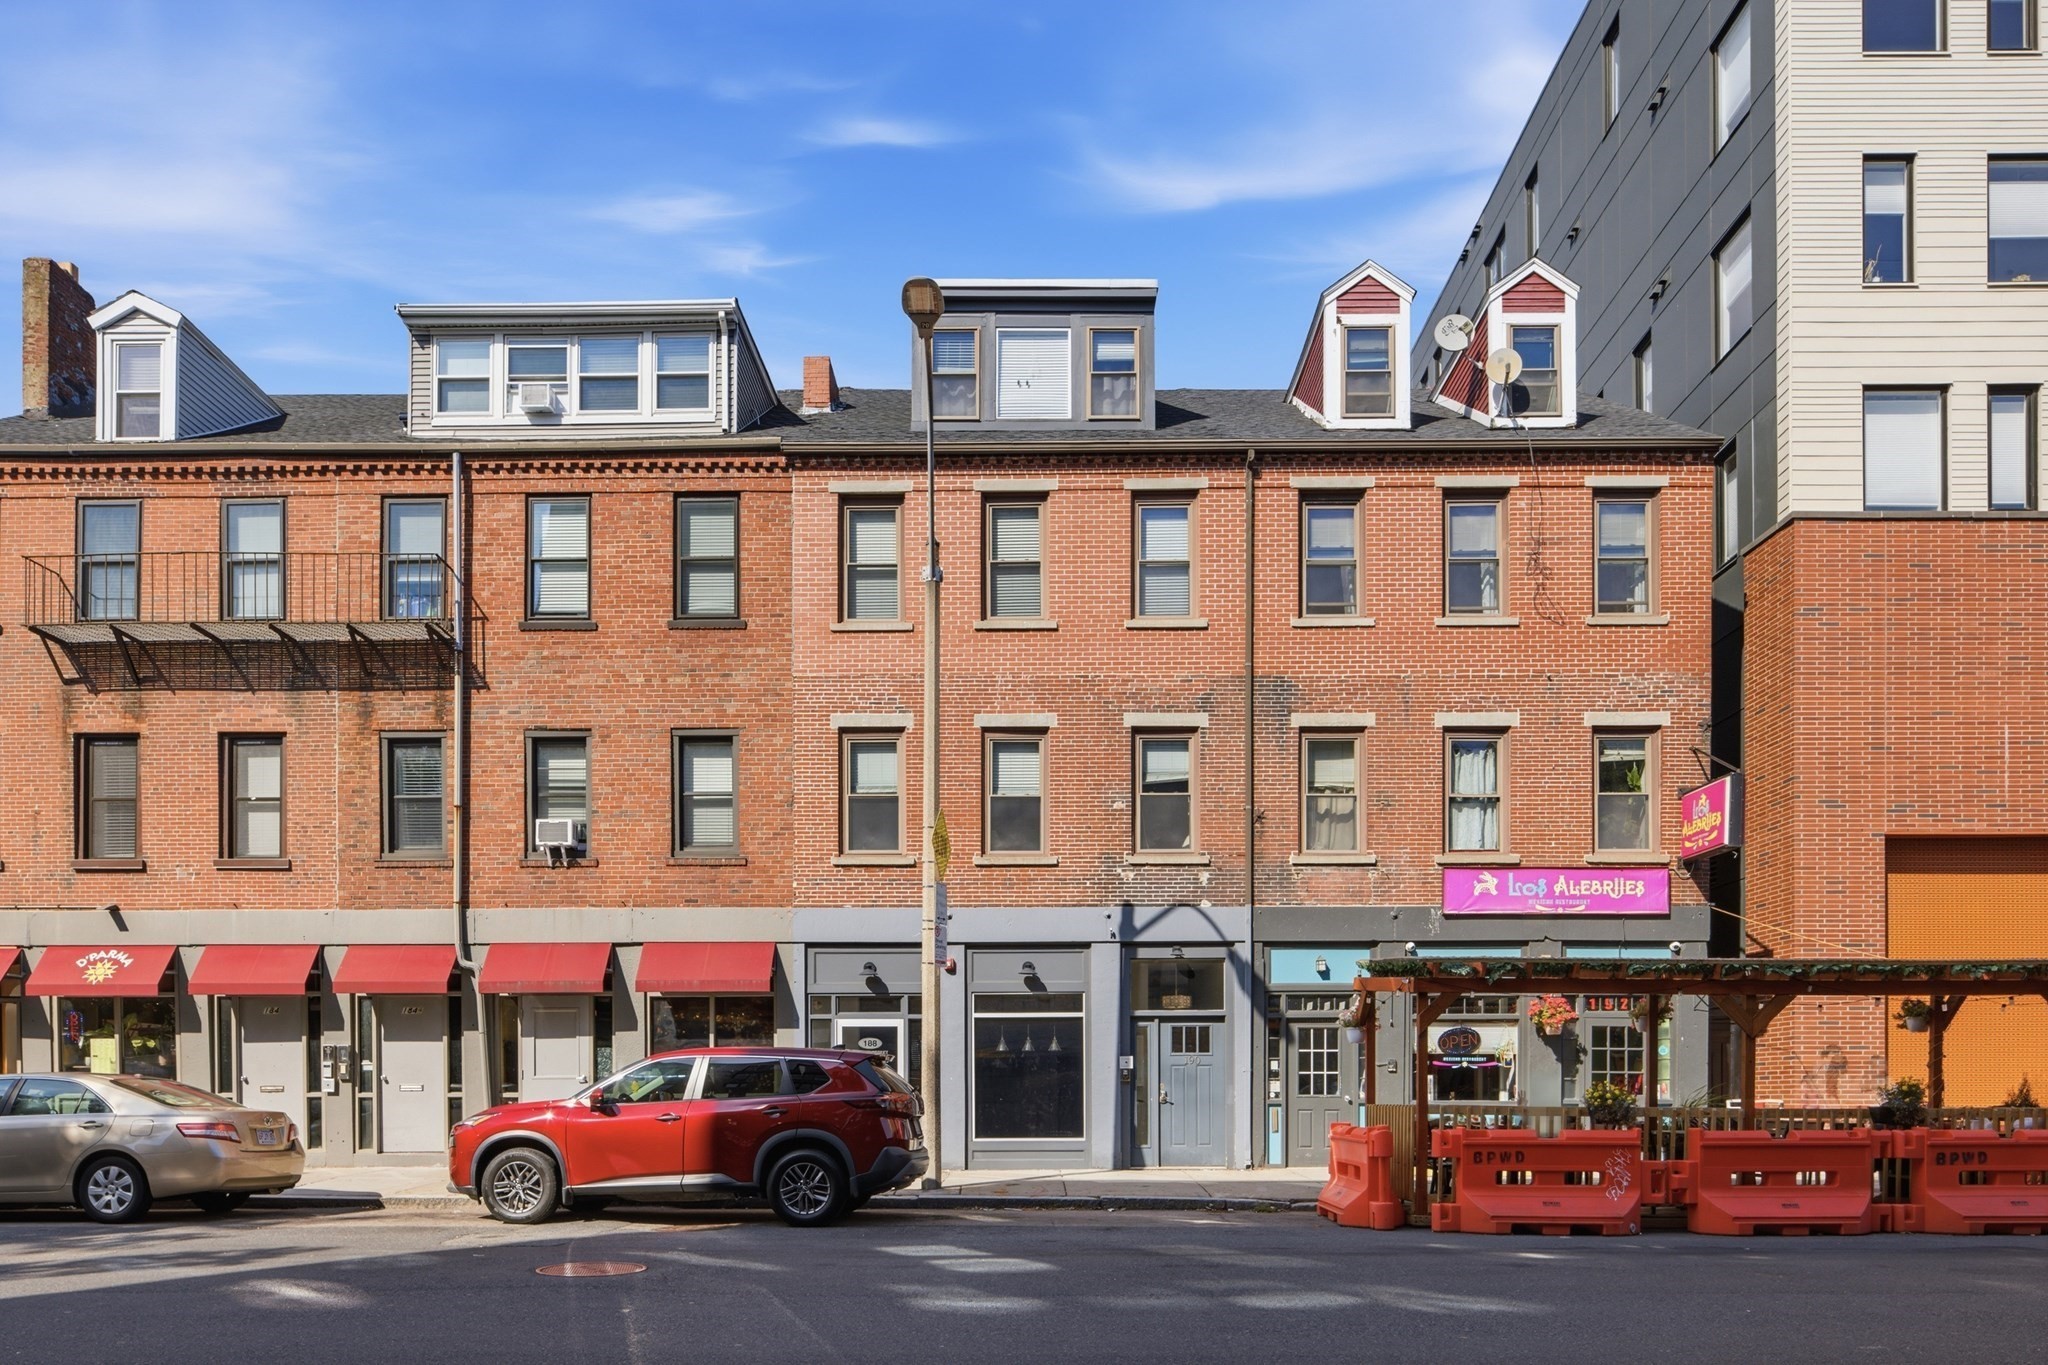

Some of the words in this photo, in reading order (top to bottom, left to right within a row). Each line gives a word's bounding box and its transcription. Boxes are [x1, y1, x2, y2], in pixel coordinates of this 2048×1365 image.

[1553, 874, 1645, 899] ALEBRIJES
[75, 949, 134, 968] D'PARMA
[863, 1039, 878, 1047] 188
[1440, 1033, 1478, 1050] OPEN
[1184, 1056, 1201, 1066] 190
[1473, 1150, 1525, 1165] BPWD
[1936, 1151, 1988, 1166] BPWD
